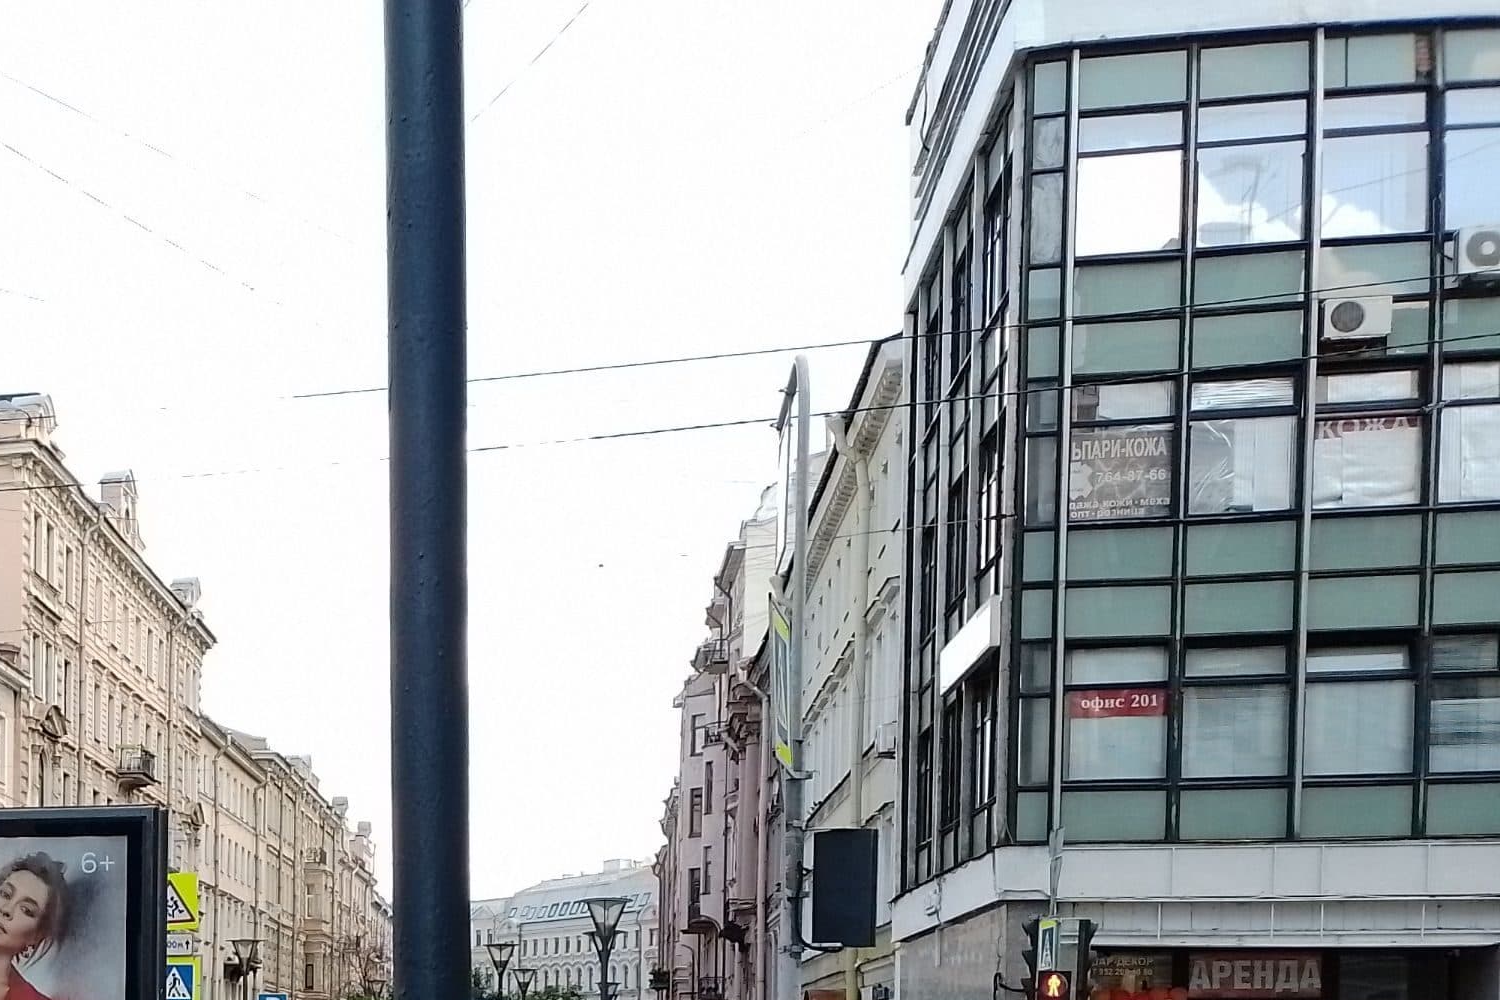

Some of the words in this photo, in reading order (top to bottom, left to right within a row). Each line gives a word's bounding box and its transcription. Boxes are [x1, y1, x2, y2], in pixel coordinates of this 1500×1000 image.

[1081, 696, 1125, 711] офис
[1131, 694, 1157, 708] 201
[81, 852, 115, 874] 6+
[1189, 959, 1322, 993] АРЕНДА
